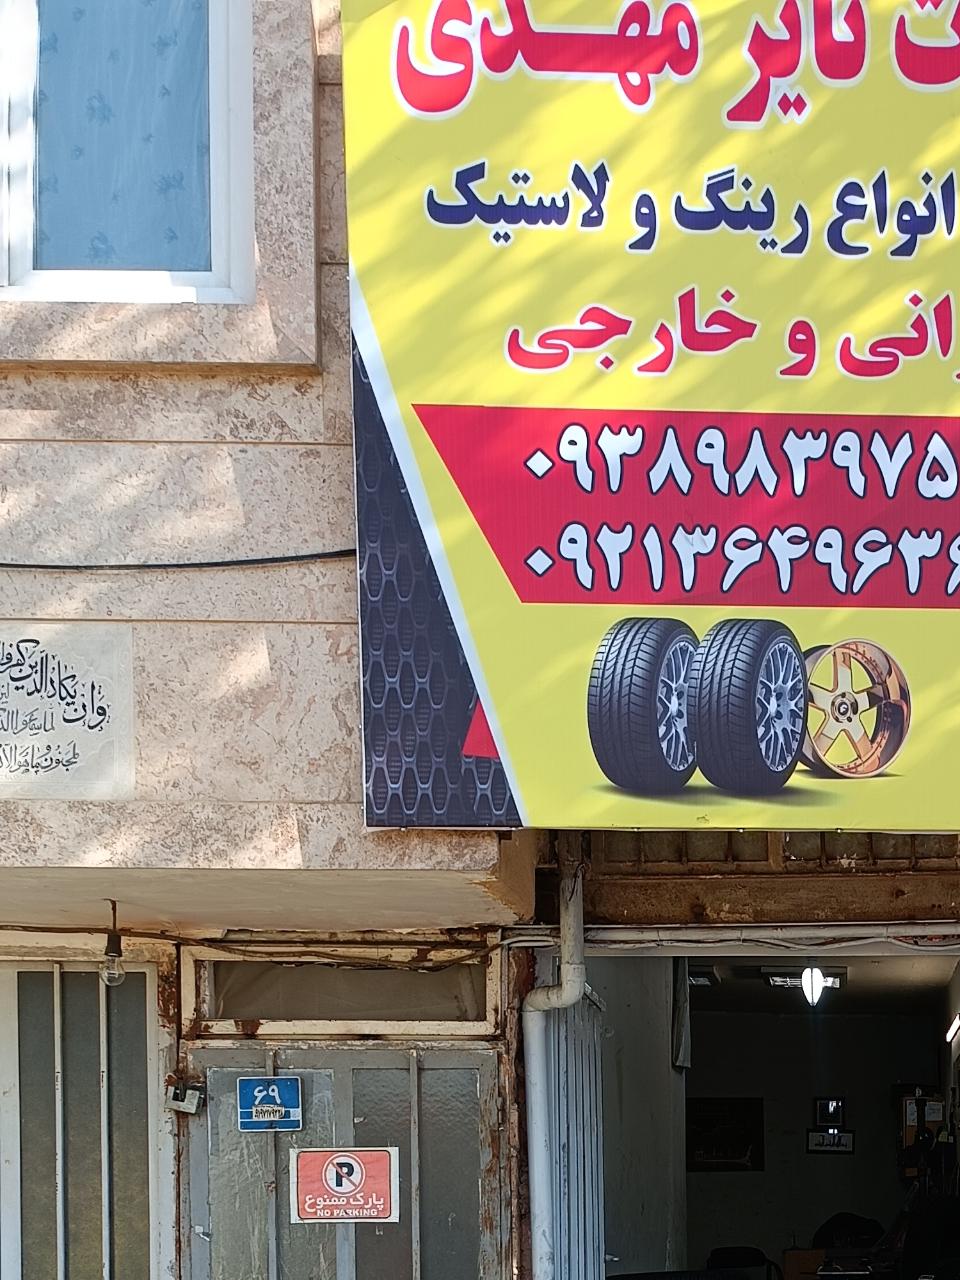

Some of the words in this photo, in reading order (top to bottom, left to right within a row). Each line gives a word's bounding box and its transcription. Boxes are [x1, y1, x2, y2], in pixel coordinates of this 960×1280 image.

[397, 0, 699, 112] مهدی
[427, 161, 610, 243] لاستیک
[628, 193, 657, 250] و
[674, 168, 809, 254] رینگ
[827, 169, 956, 257] انواع
[508, 287, 757, 373] خارجی
[779, 320, 816, 376] و
[253, 1085, 281, 1105] ۶۹
[304, 1194, 347, 1213] ممنوع
[317, 1209, 332, 1217] NO
[333, 1208, 378, 1217] PARKING
[350, 1192, 385, 1211] پارک
